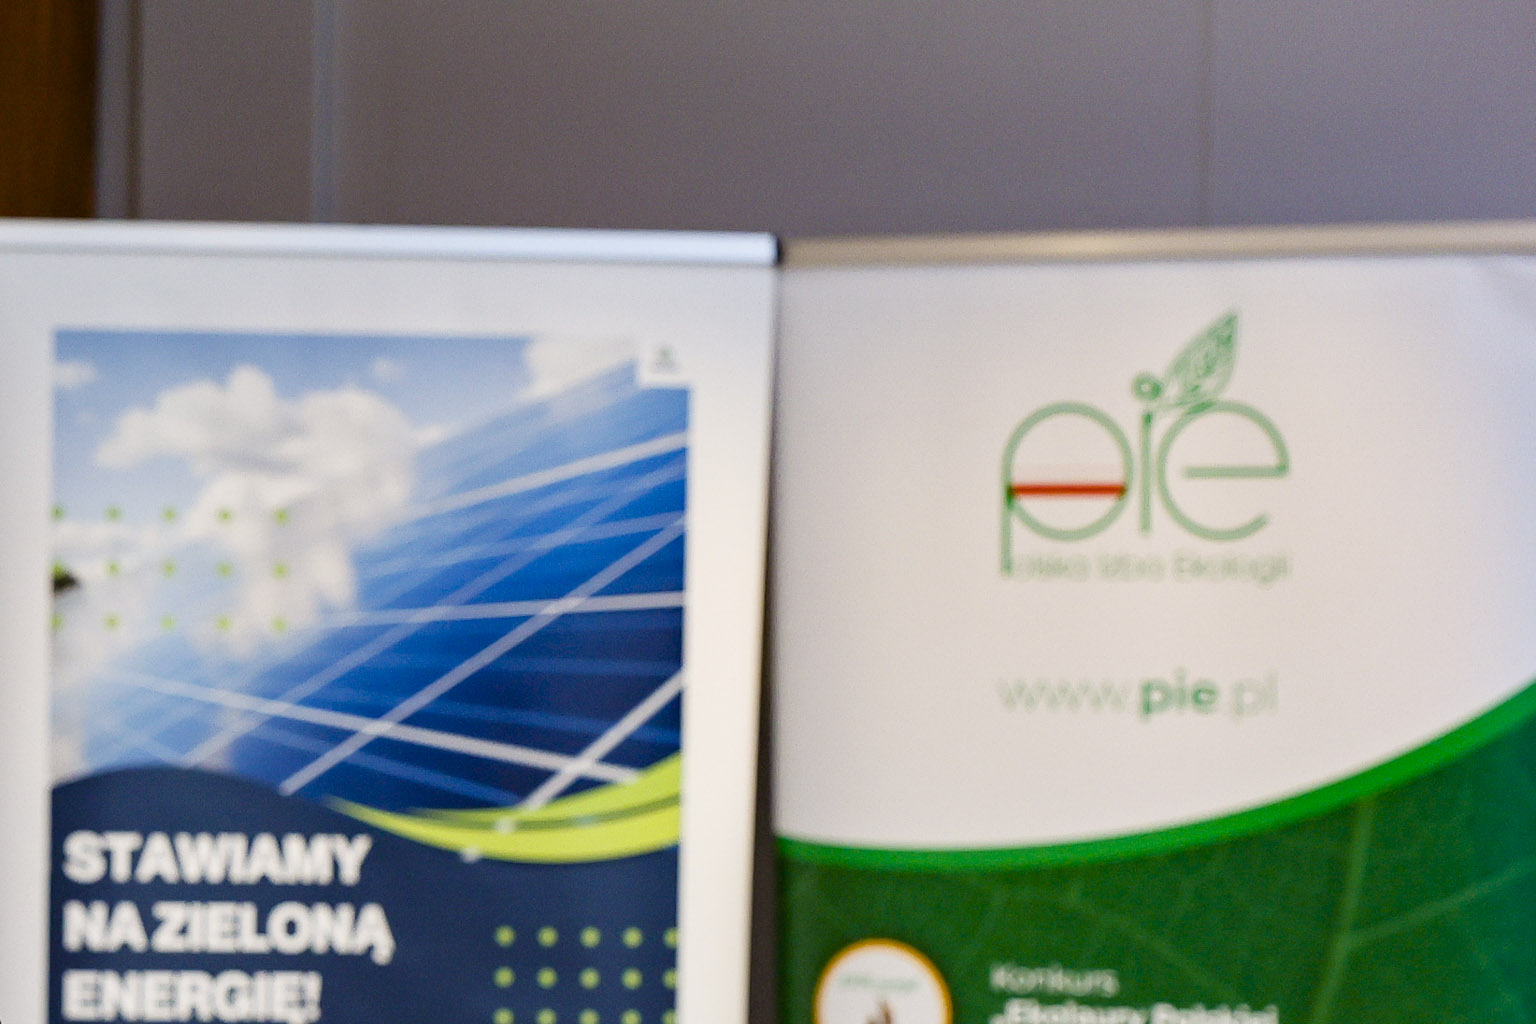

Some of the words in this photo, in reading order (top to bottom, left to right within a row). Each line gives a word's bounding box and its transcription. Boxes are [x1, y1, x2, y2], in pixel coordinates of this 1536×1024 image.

[997, 668, 1280, 722] www.pie.pl
[64, 831, 371, 885] STAWIAMY
[63, 902, 149, 952] NA
[151, 902, 395, 965] ZIELONĄ
[990, 963, 1119, 997] Konkurs
